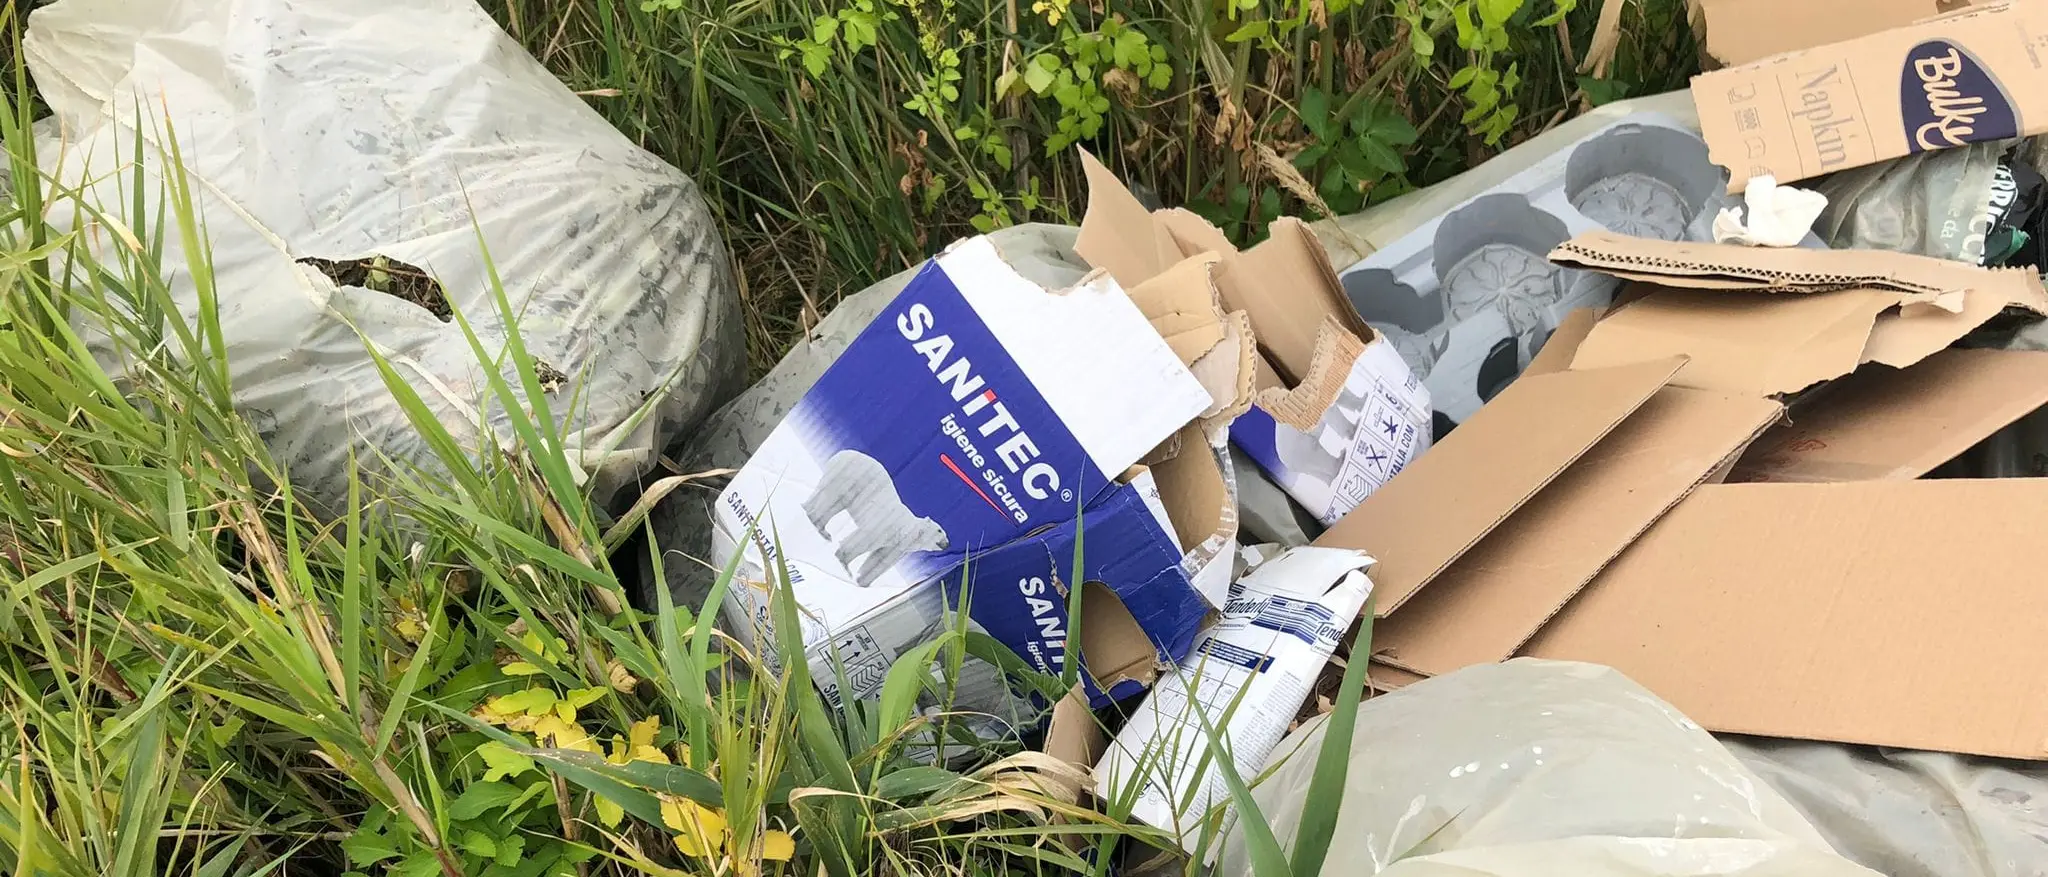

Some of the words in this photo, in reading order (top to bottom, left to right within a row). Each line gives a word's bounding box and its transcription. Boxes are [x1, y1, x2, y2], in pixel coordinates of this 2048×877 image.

[1791, 63, 1858, 171] Napkin
[1915, 47, 1987, 151] Bulky
[940, 412, 986, 469] igiene
[981, 468, 1029, 524] sicura
[1222, 597, 1270, 620] Tenderly
